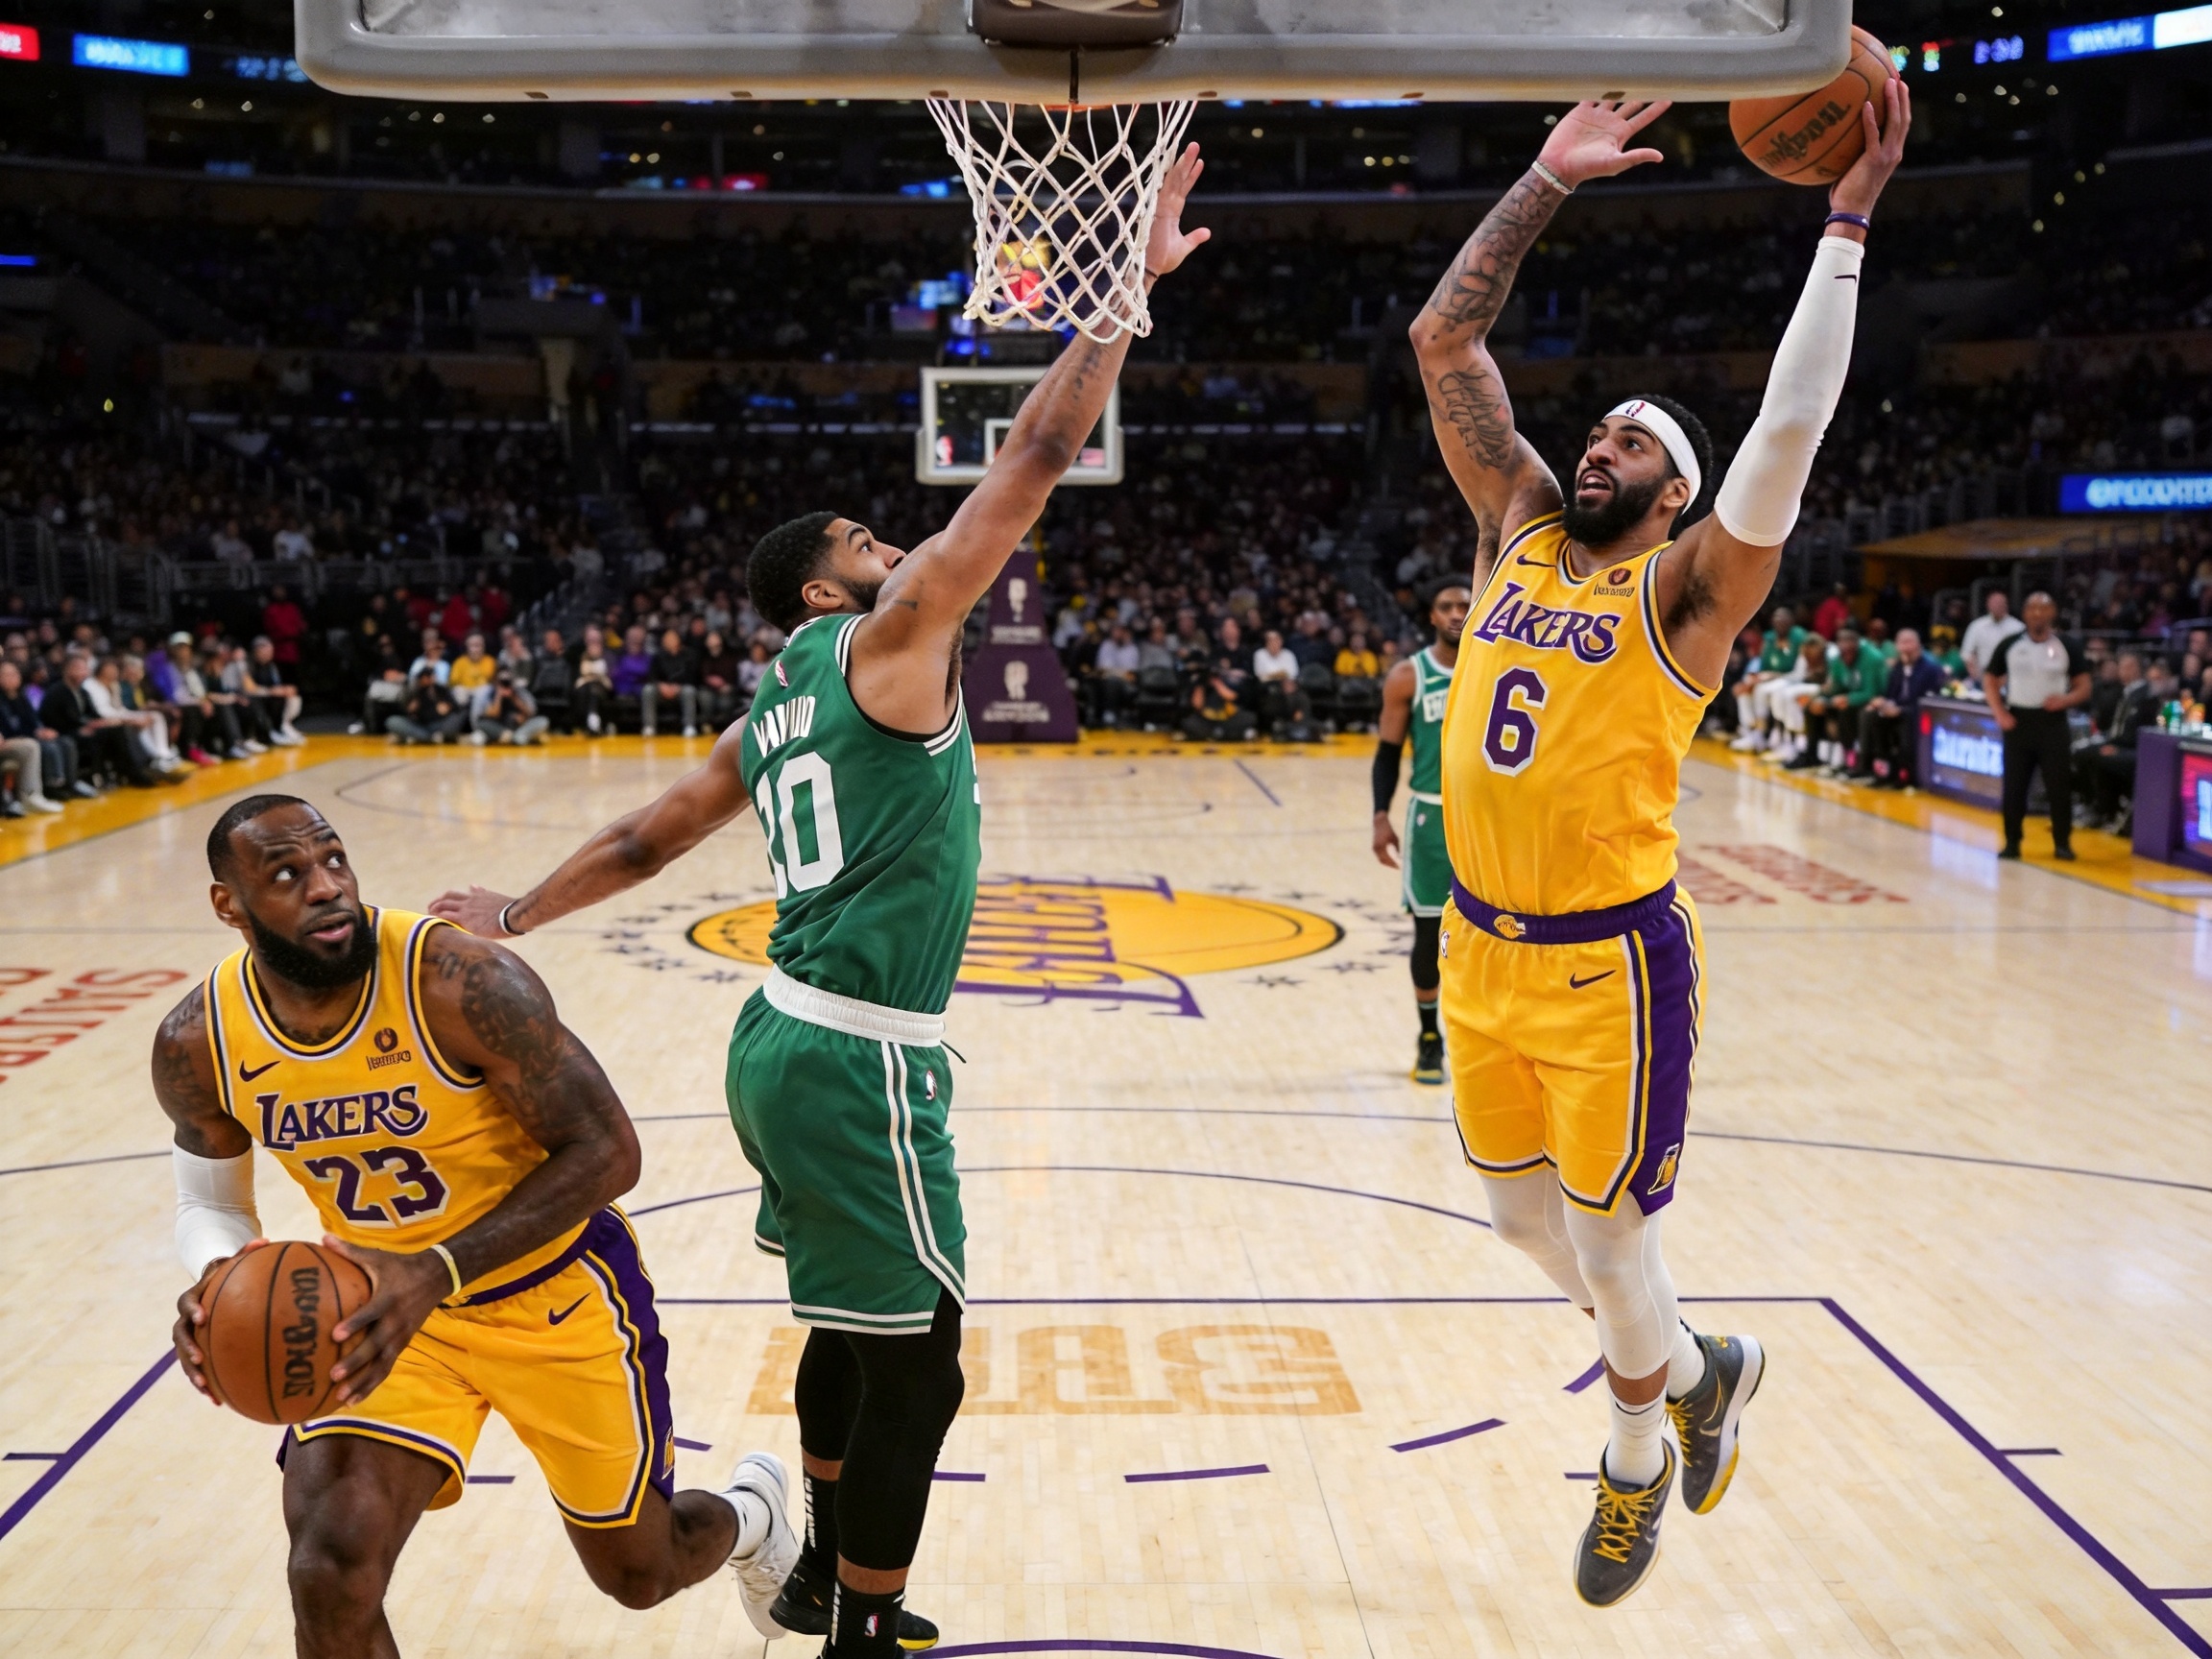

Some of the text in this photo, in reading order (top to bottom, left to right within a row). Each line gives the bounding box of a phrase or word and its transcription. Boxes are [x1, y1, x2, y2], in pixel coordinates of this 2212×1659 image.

[1473, 582, 1622, 663] LAKERS
[1482, 665, 1549, 777] 6
[255, 1083, 429, 1152] LAKERS
[302, 1145, 451, 1229] 23
